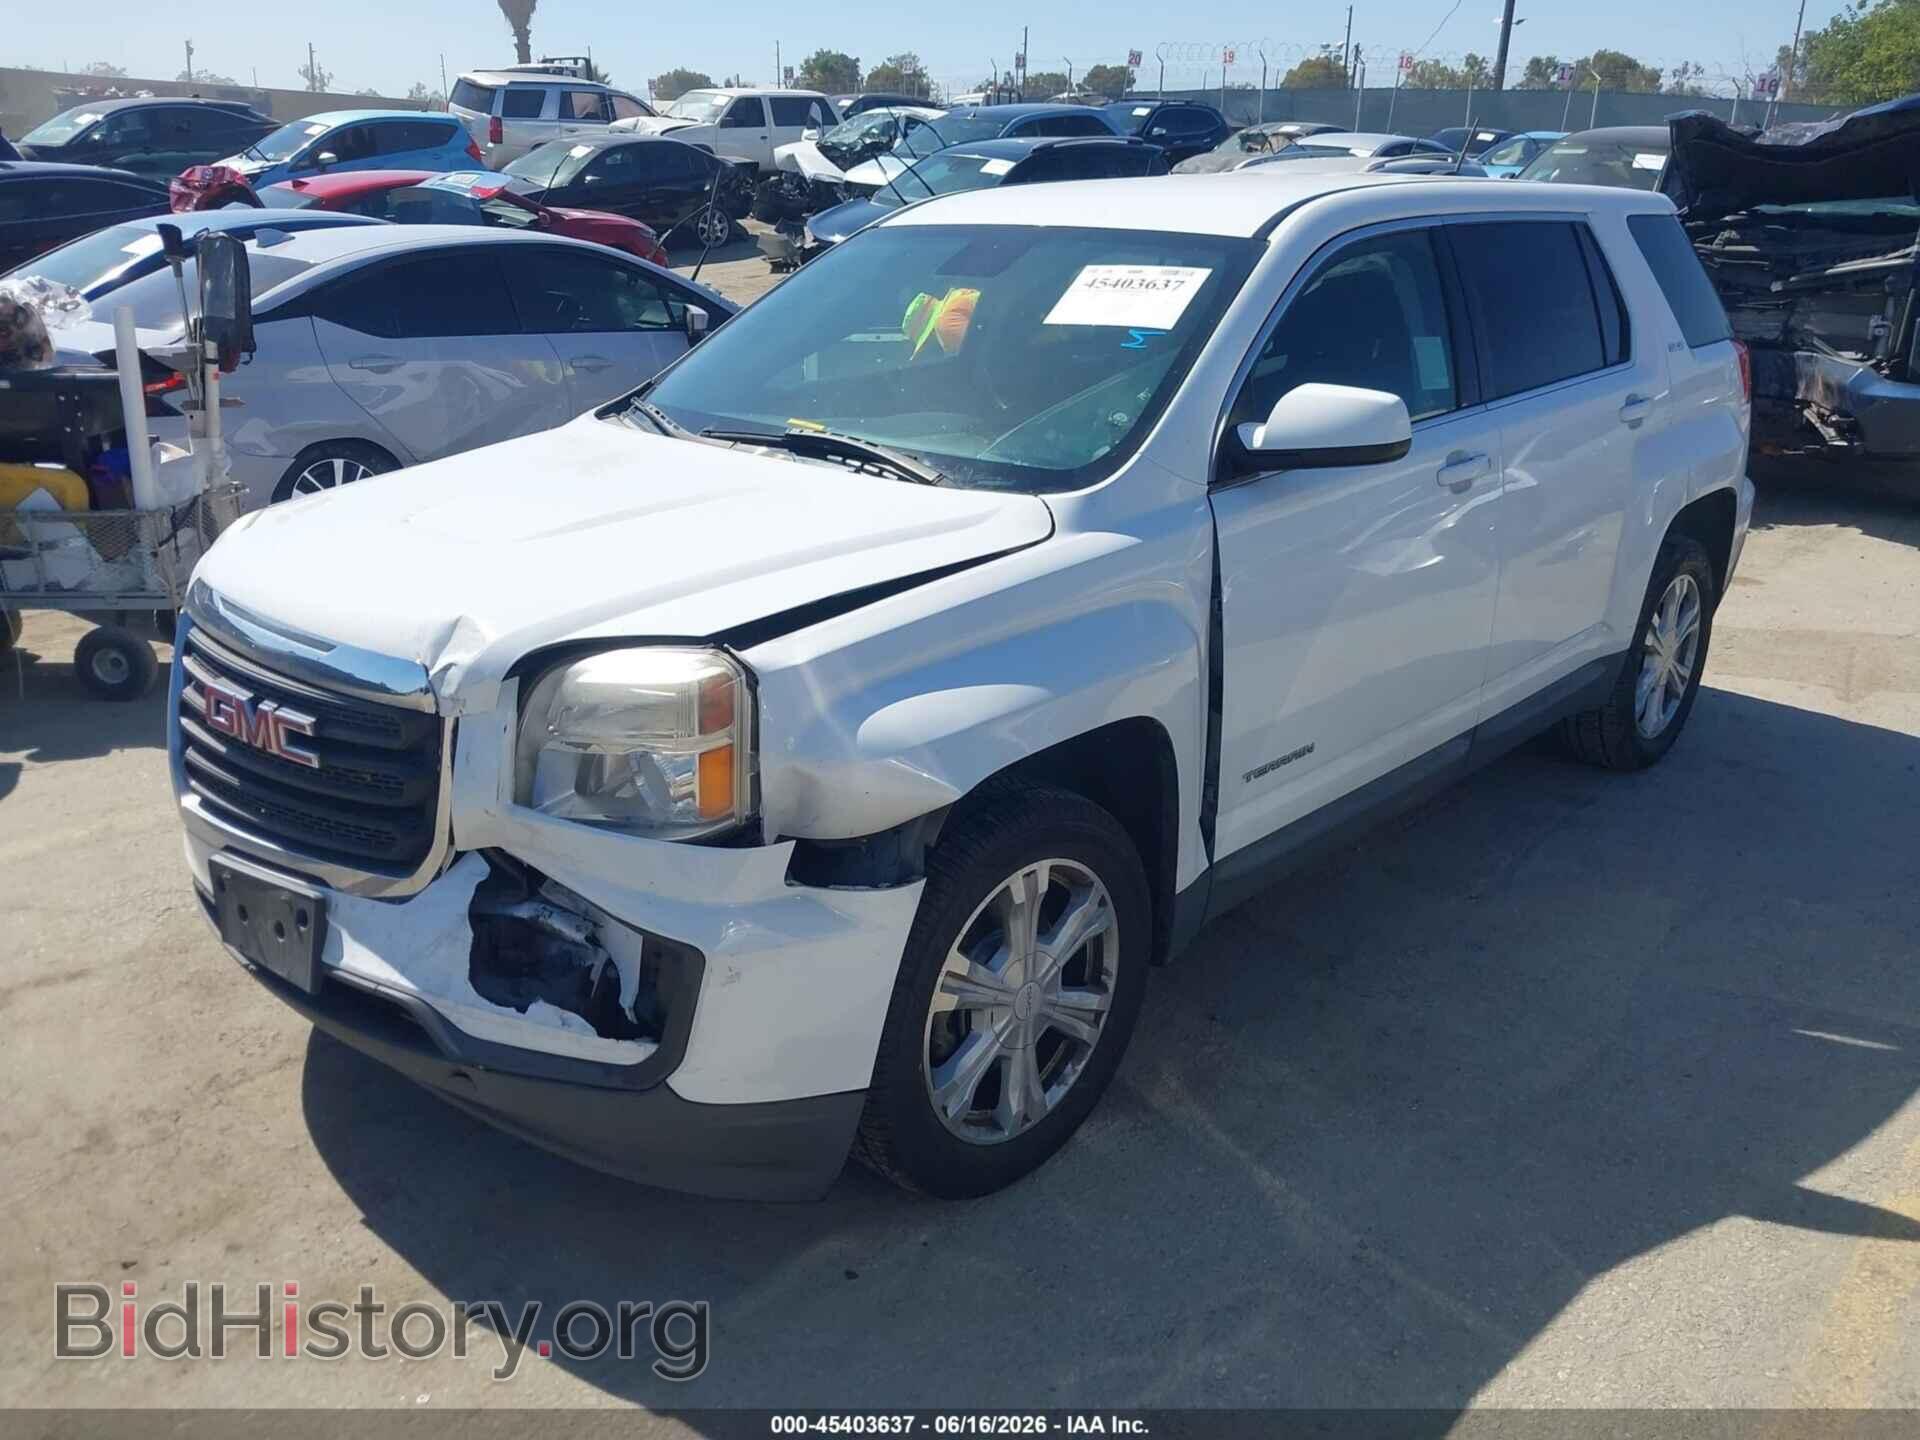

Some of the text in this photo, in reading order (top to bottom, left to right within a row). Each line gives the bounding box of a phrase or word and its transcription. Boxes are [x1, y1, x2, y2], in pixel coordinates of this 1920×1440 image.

[1128, 51, 1141, 65] 20
[1223, 51, 1234, 64] 19
[1399, 55, 1413, 69] 18
[1557, 66, 1575, 81] 17
[1083, 277, 1187, 291] 45403637
[203, 683, 319, 769] GMC
[1242, 742, 1315, 783] TERRAIN
